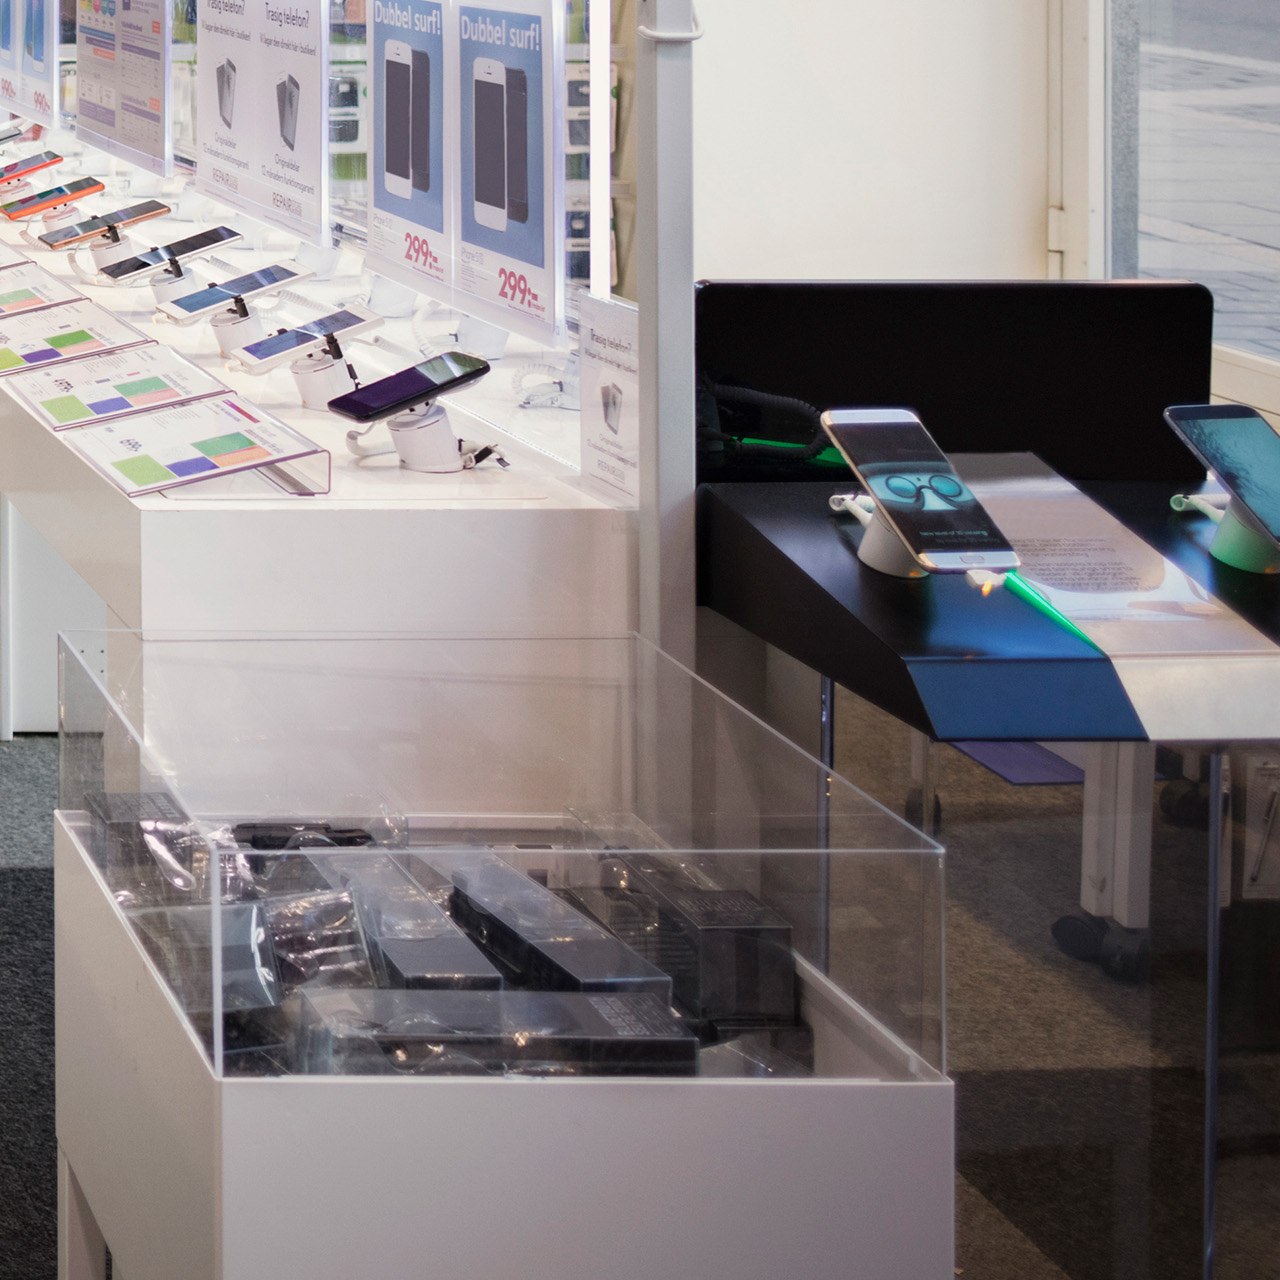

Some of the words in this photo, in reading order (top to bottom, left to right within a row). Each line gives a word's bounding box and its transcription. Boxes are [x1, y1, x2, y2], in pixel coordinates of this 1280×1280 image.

[265, 2, 283, 27] Trasig
[283, 9, 310, 29] telefon?
[374, 0, 412, 31] Dubbel
[413, 10, 441, 36] surf!
[460, 15, 506, 45] Dubbel
[509, 24, 540, 52] surf!
[212, 168, 229, 185] REPAIR
[272, 192, 291, 211] REPAIR
[404, 232, 438, 270] 299:-
[498, 267, 538, 309] 299:-
[590, 328, 607, 349] Trasig
[607, 334, 632, 355] telefon?
